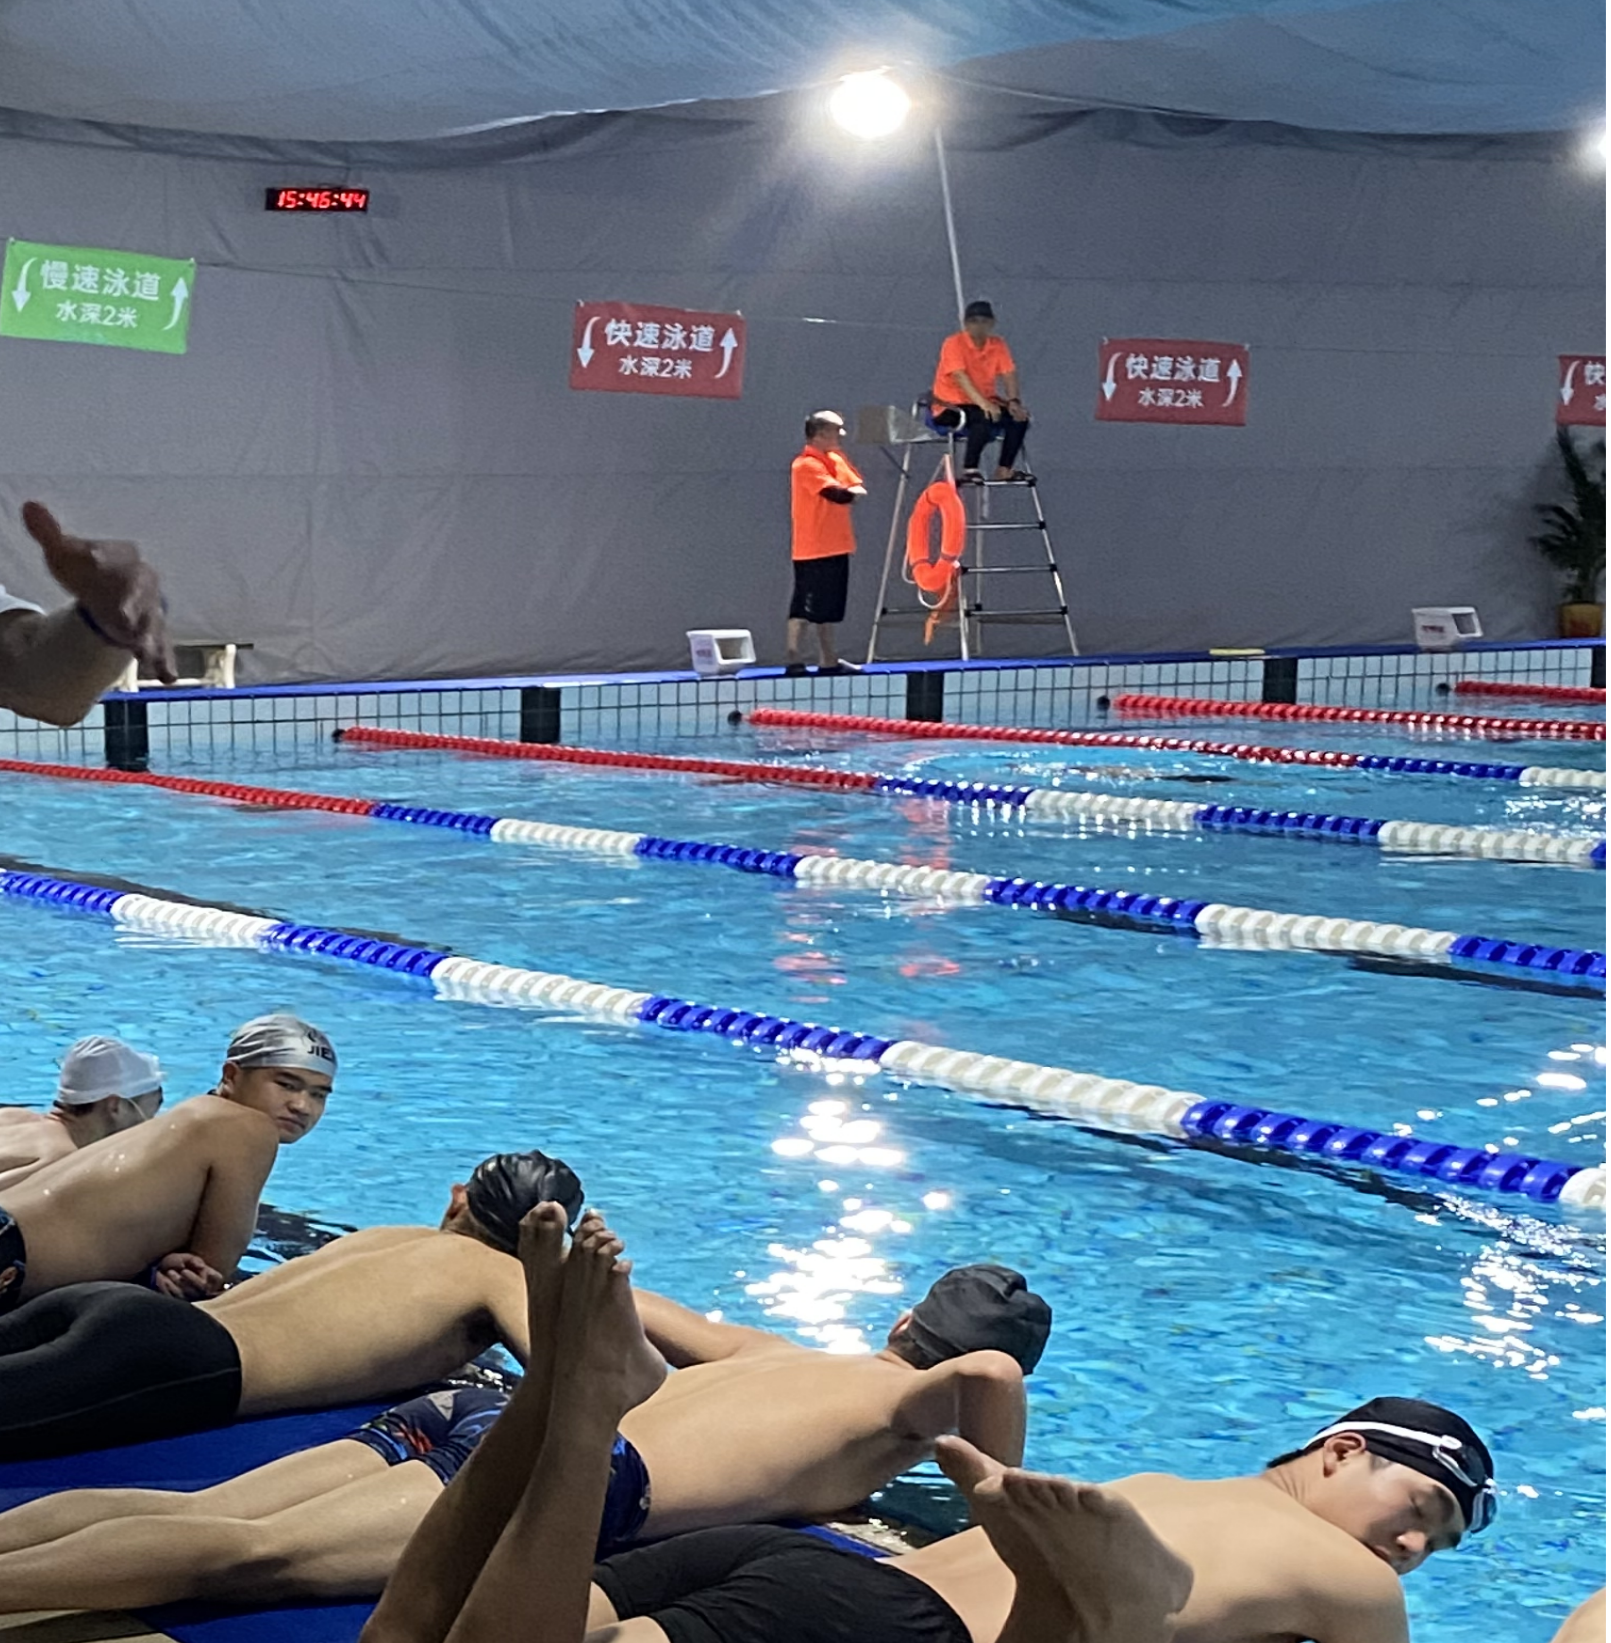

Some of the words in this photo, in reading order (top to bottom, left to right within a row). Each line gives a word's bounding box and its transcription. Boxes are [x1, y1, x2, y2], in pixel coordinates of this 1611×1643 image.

[278, 190, 366, 208] 15:46:44
[40, 259, 161, 301] 慢速泳道
[56, 300, 138, 329] 水深2米
[604, 318, 715, 352] 快速泳道
[618, 355, 693, 379] 水深2米
[1125, 353, 1221, 382] 快速泳道
[1138, 387, 1205, 409] 水深2米
